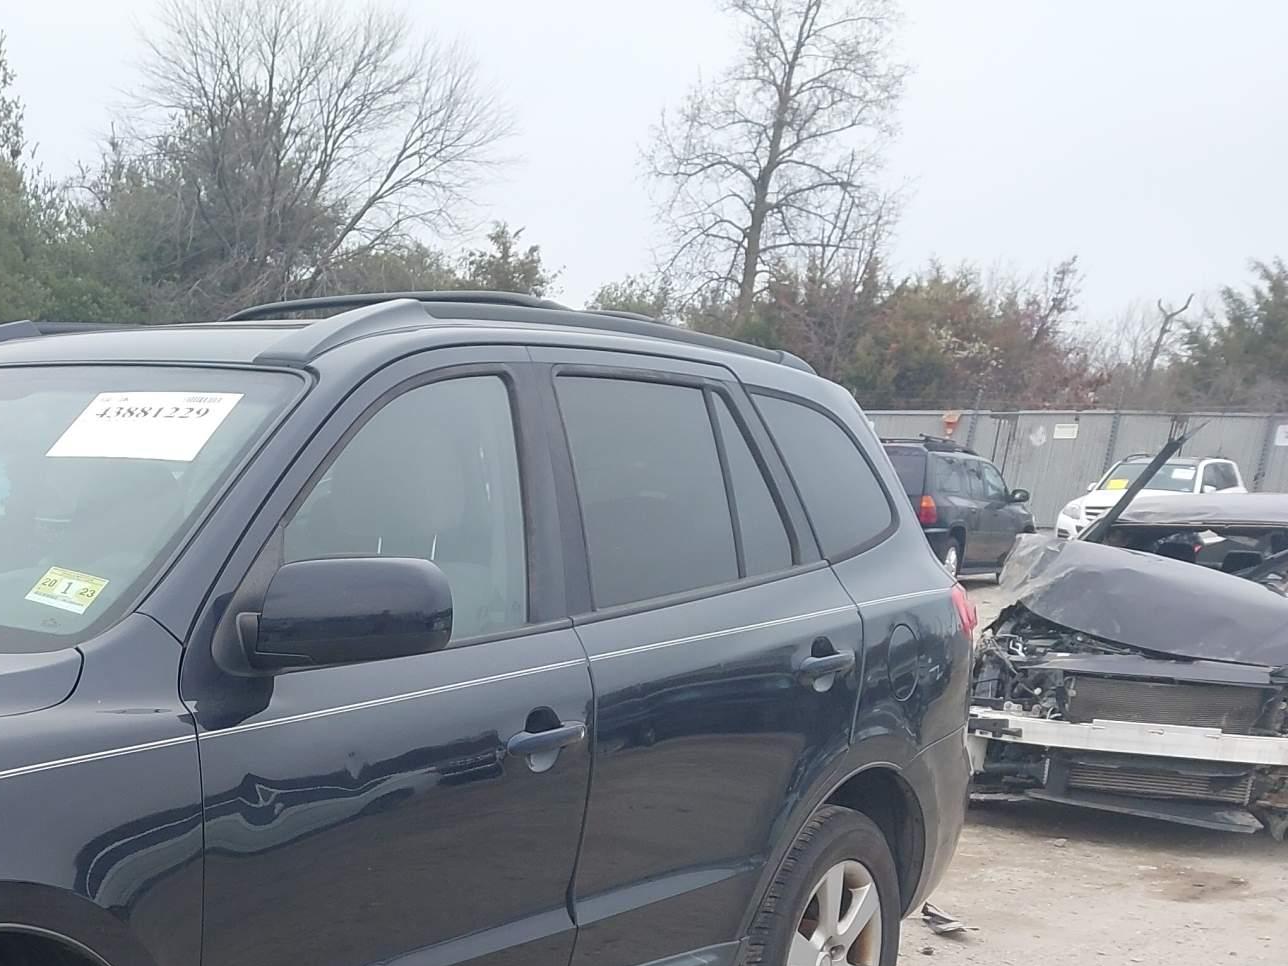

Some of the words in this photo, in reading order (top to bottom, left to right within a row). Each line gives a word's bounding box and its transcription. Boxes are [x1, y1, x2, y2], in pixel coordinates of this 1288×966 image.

[95, 406, 211, 419] 43881229
[41, 577, 58, 588] 20
[60, 581, 73, 595] 1
[79, 587, 97, 598] 23
